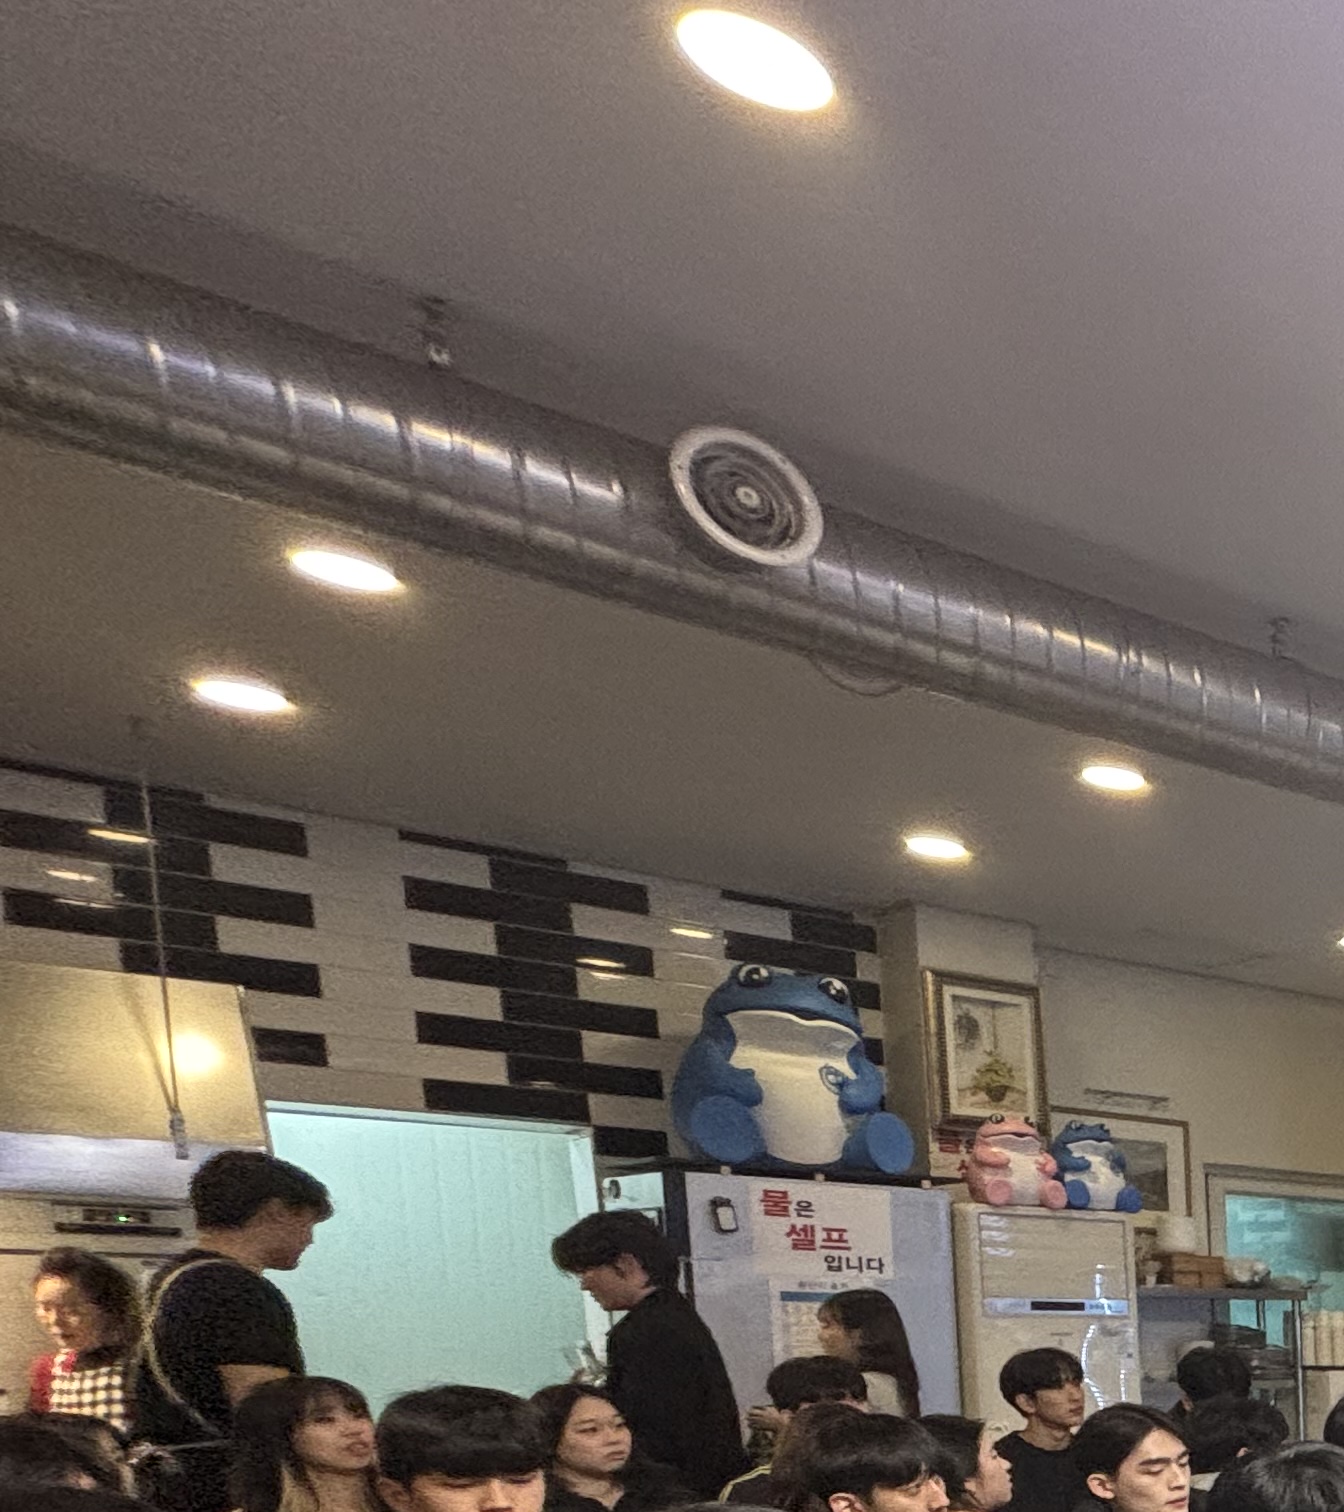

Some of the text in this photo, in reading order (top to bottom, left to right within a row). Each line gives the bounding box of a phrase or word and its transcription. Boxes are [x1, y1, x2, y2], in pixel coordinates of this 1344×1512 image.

[760, 1189, 815, 1219] 물은
[785, 1223, 852, 1252] 셀프
[823, 1255, 886, 1275] 입니다
